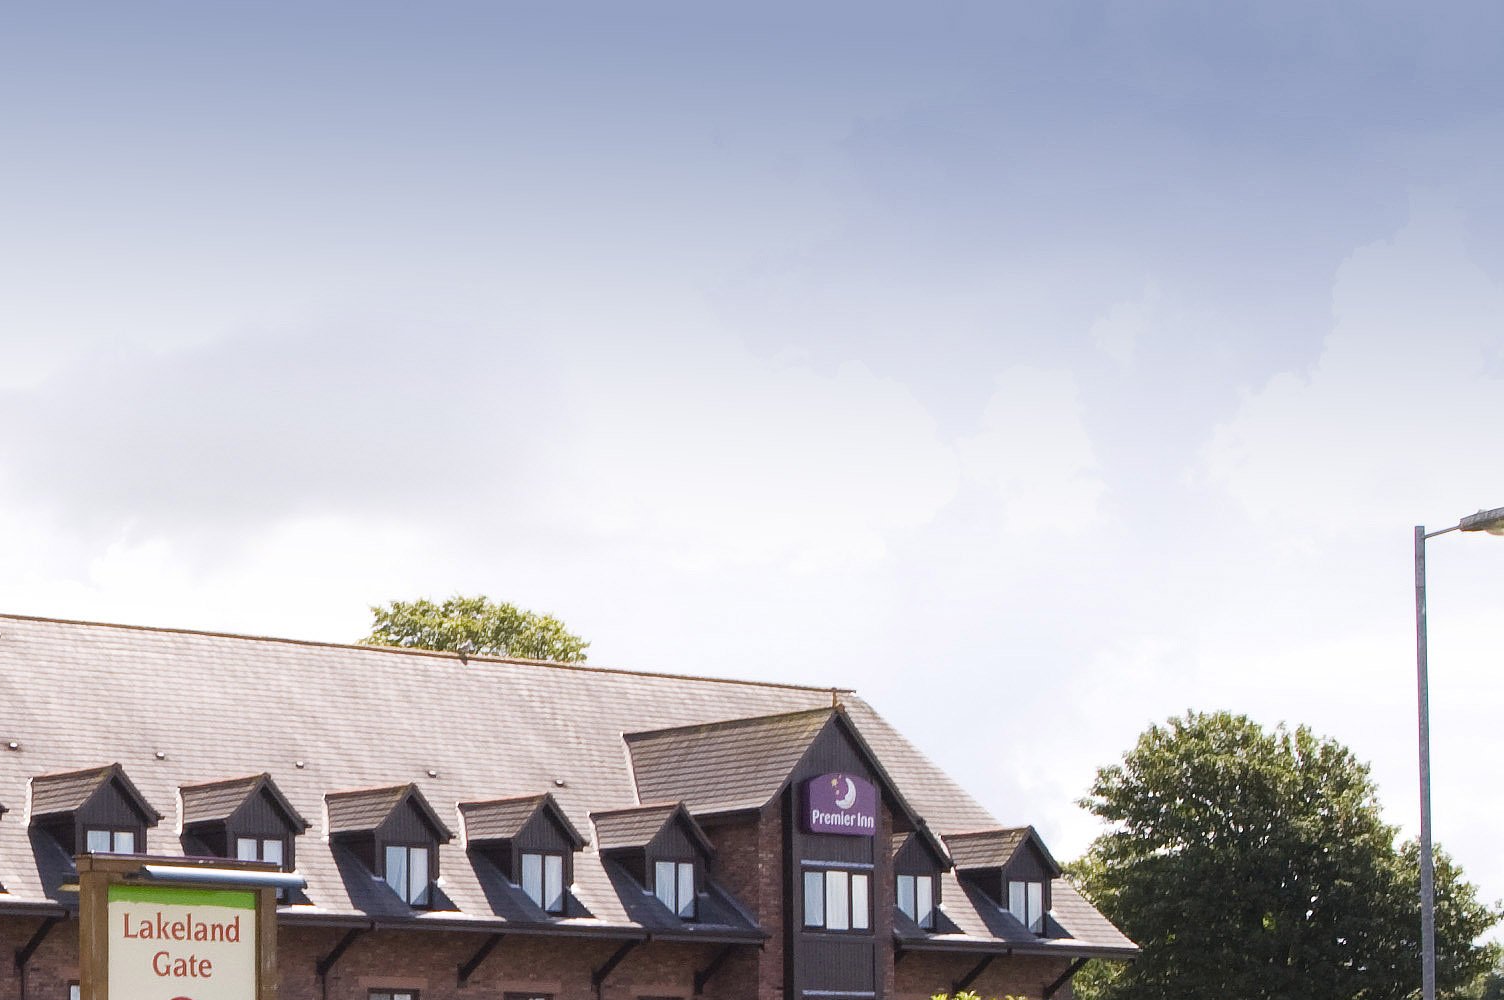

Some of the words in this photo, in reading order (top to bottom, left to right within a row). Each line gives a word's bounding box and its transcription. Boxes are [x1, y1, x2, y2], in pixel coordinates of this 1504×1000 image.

[812, 809, 856, 827] Premier
[857, 811, 875, 829] Inn
[122, 911, 241, 944] Lakeland
[152, 950, 213, 979] Gate
